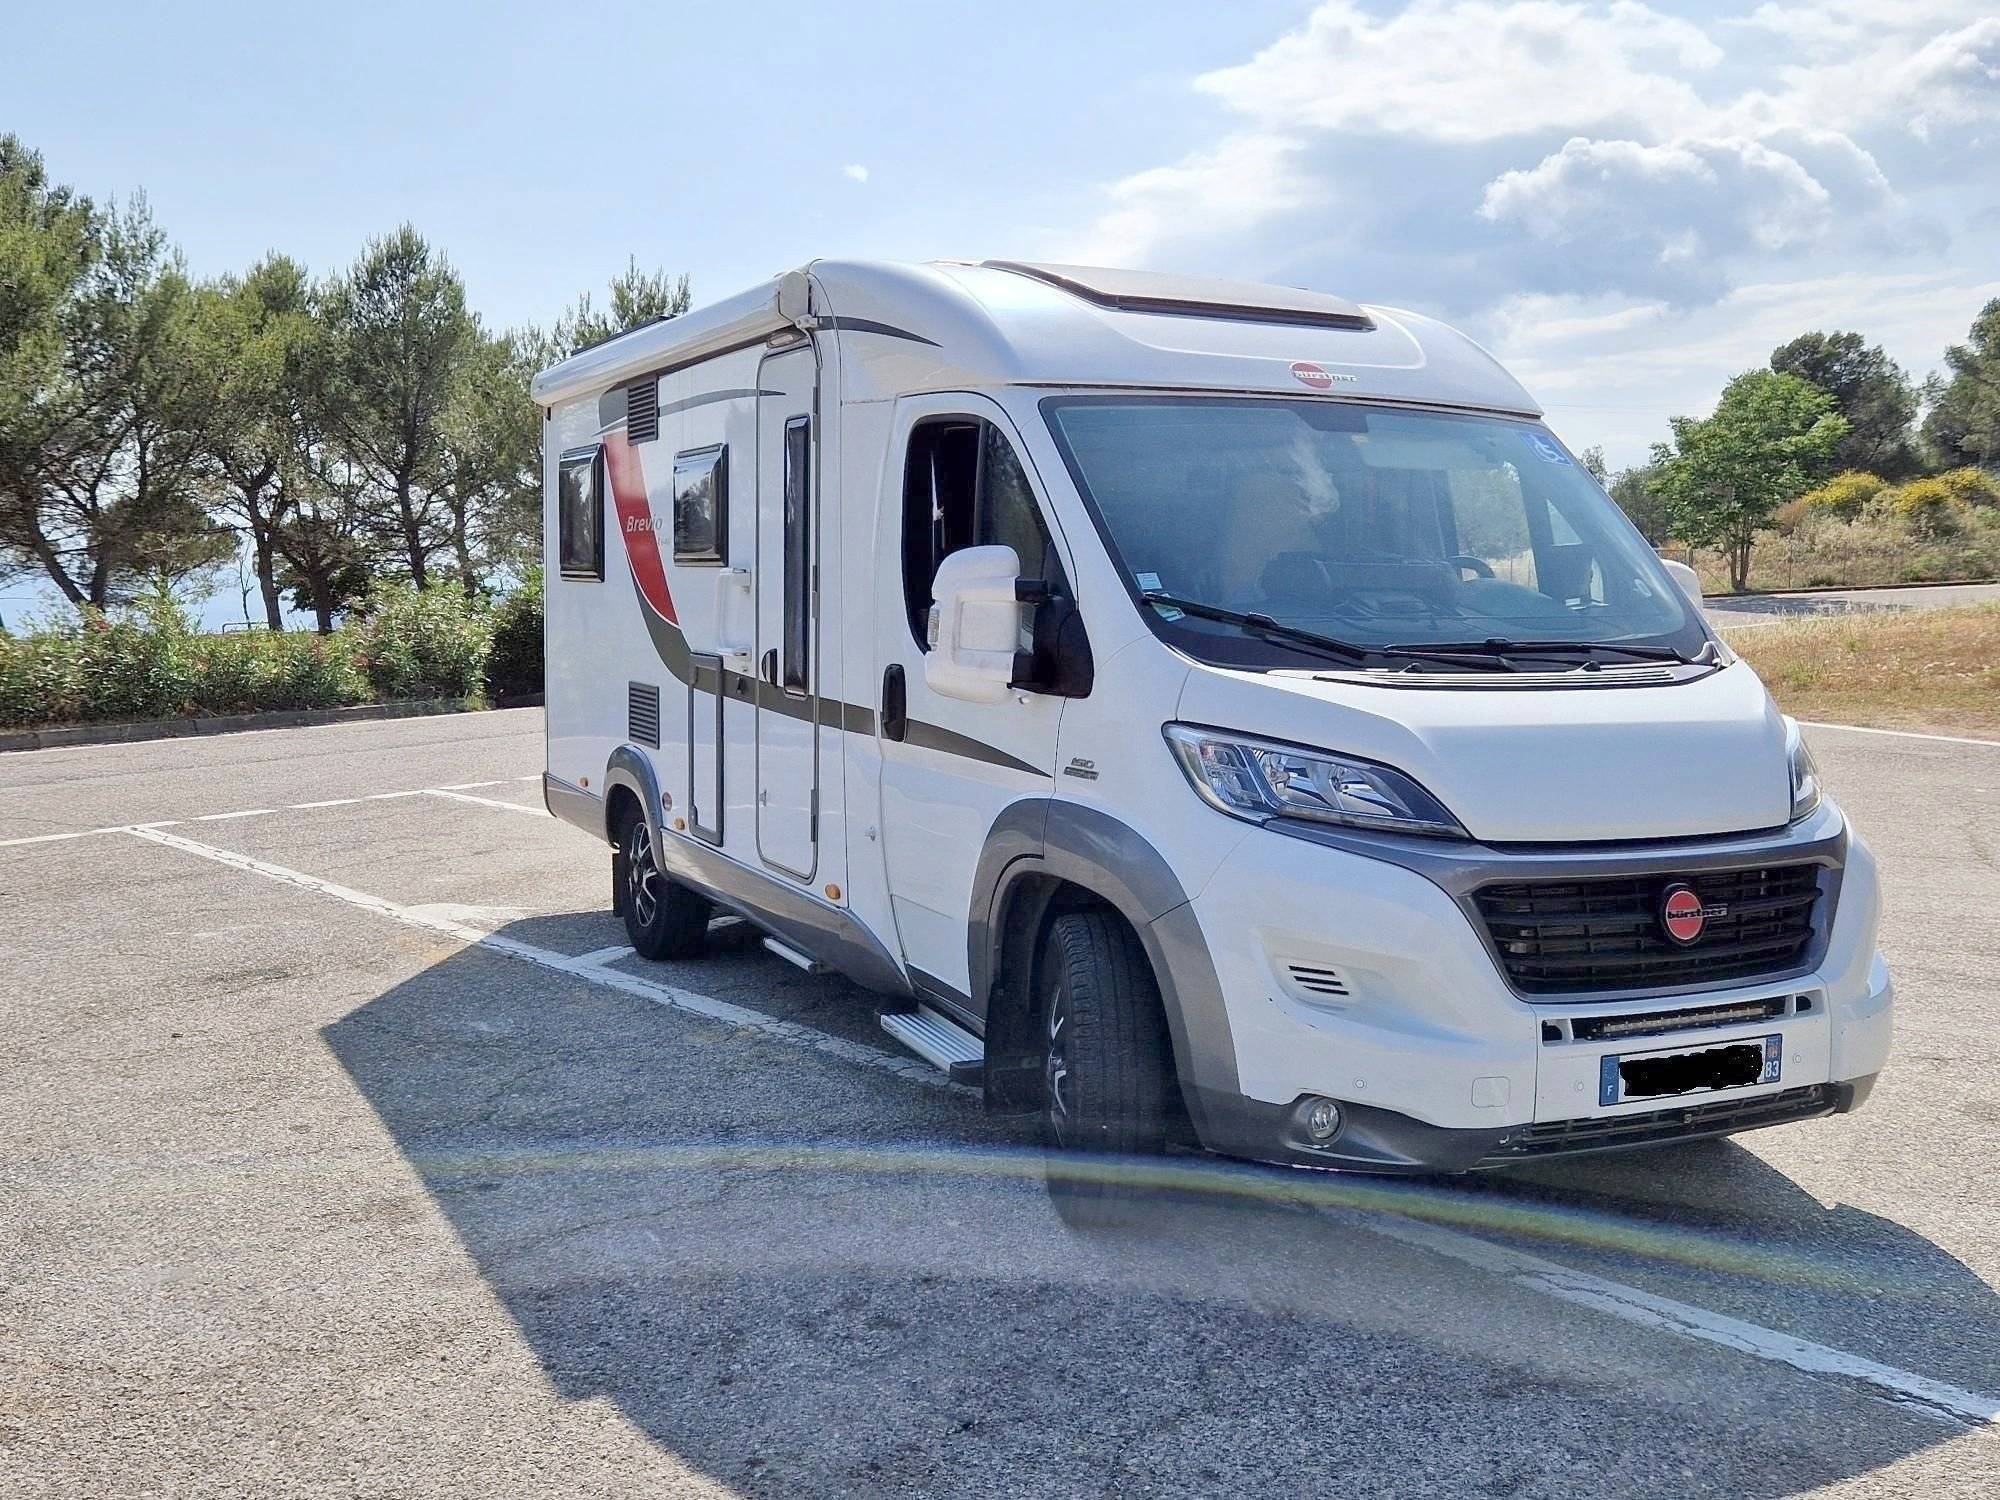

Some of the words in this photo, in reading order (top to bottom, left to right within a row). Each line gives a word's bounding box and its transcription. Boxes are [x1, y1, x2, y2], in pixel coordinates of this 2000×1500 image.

[626, 514, 663, 532] Brevio
[1765, 1060, 1779, 1078] 83
[1606, 1084, 1614, 1097] F
